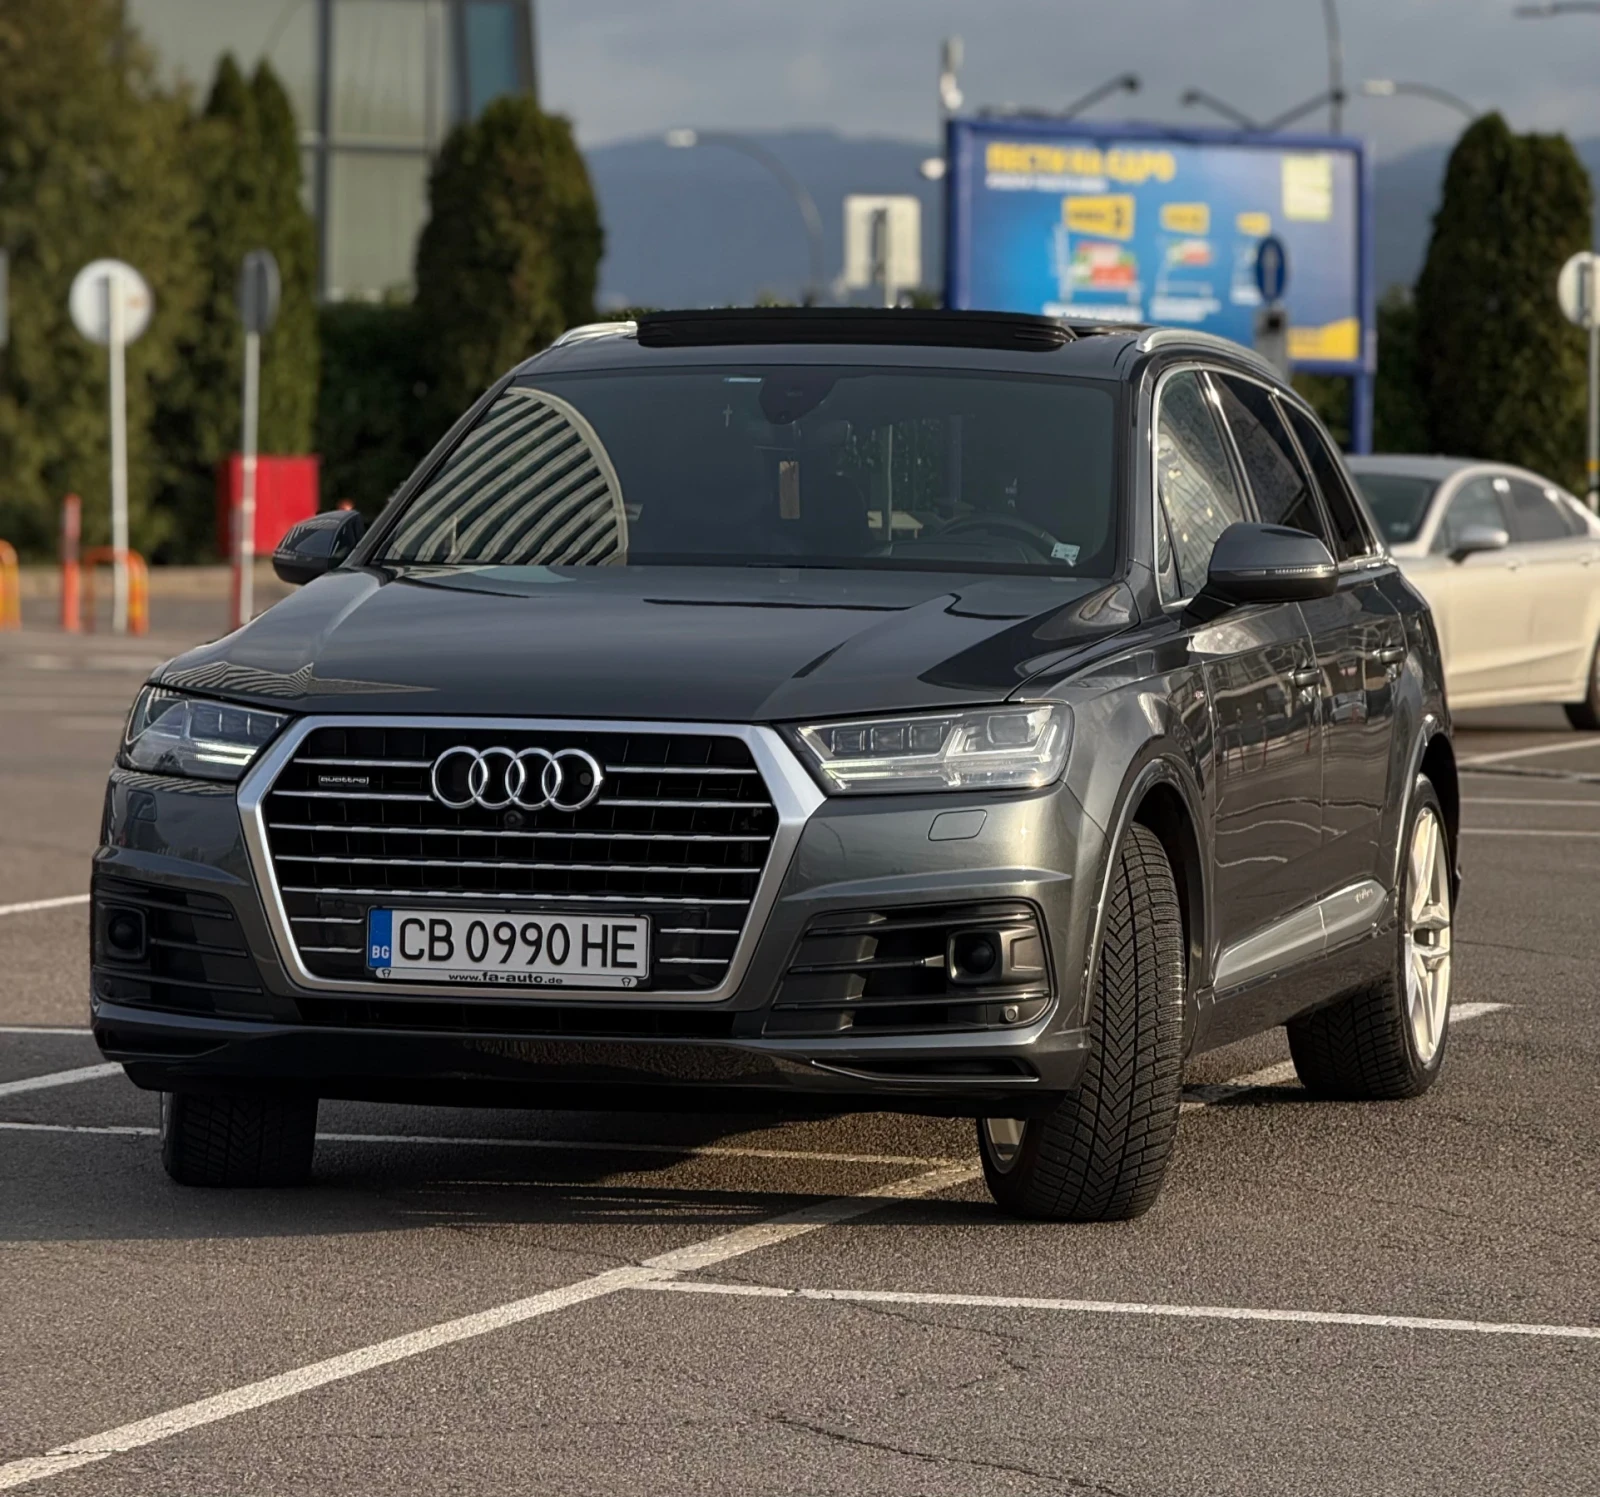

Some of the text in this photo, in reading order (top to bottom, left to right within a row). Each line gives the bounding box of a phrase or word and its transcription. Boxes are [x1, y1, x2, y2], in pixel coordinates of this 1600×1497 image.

[319, 775, 368, 784] quattro
[399, 917, 638, 969] CB 0990 HE
[371, 944, 390, 960] BG
[447, 971, 564, 985] www.fa-auto.de
